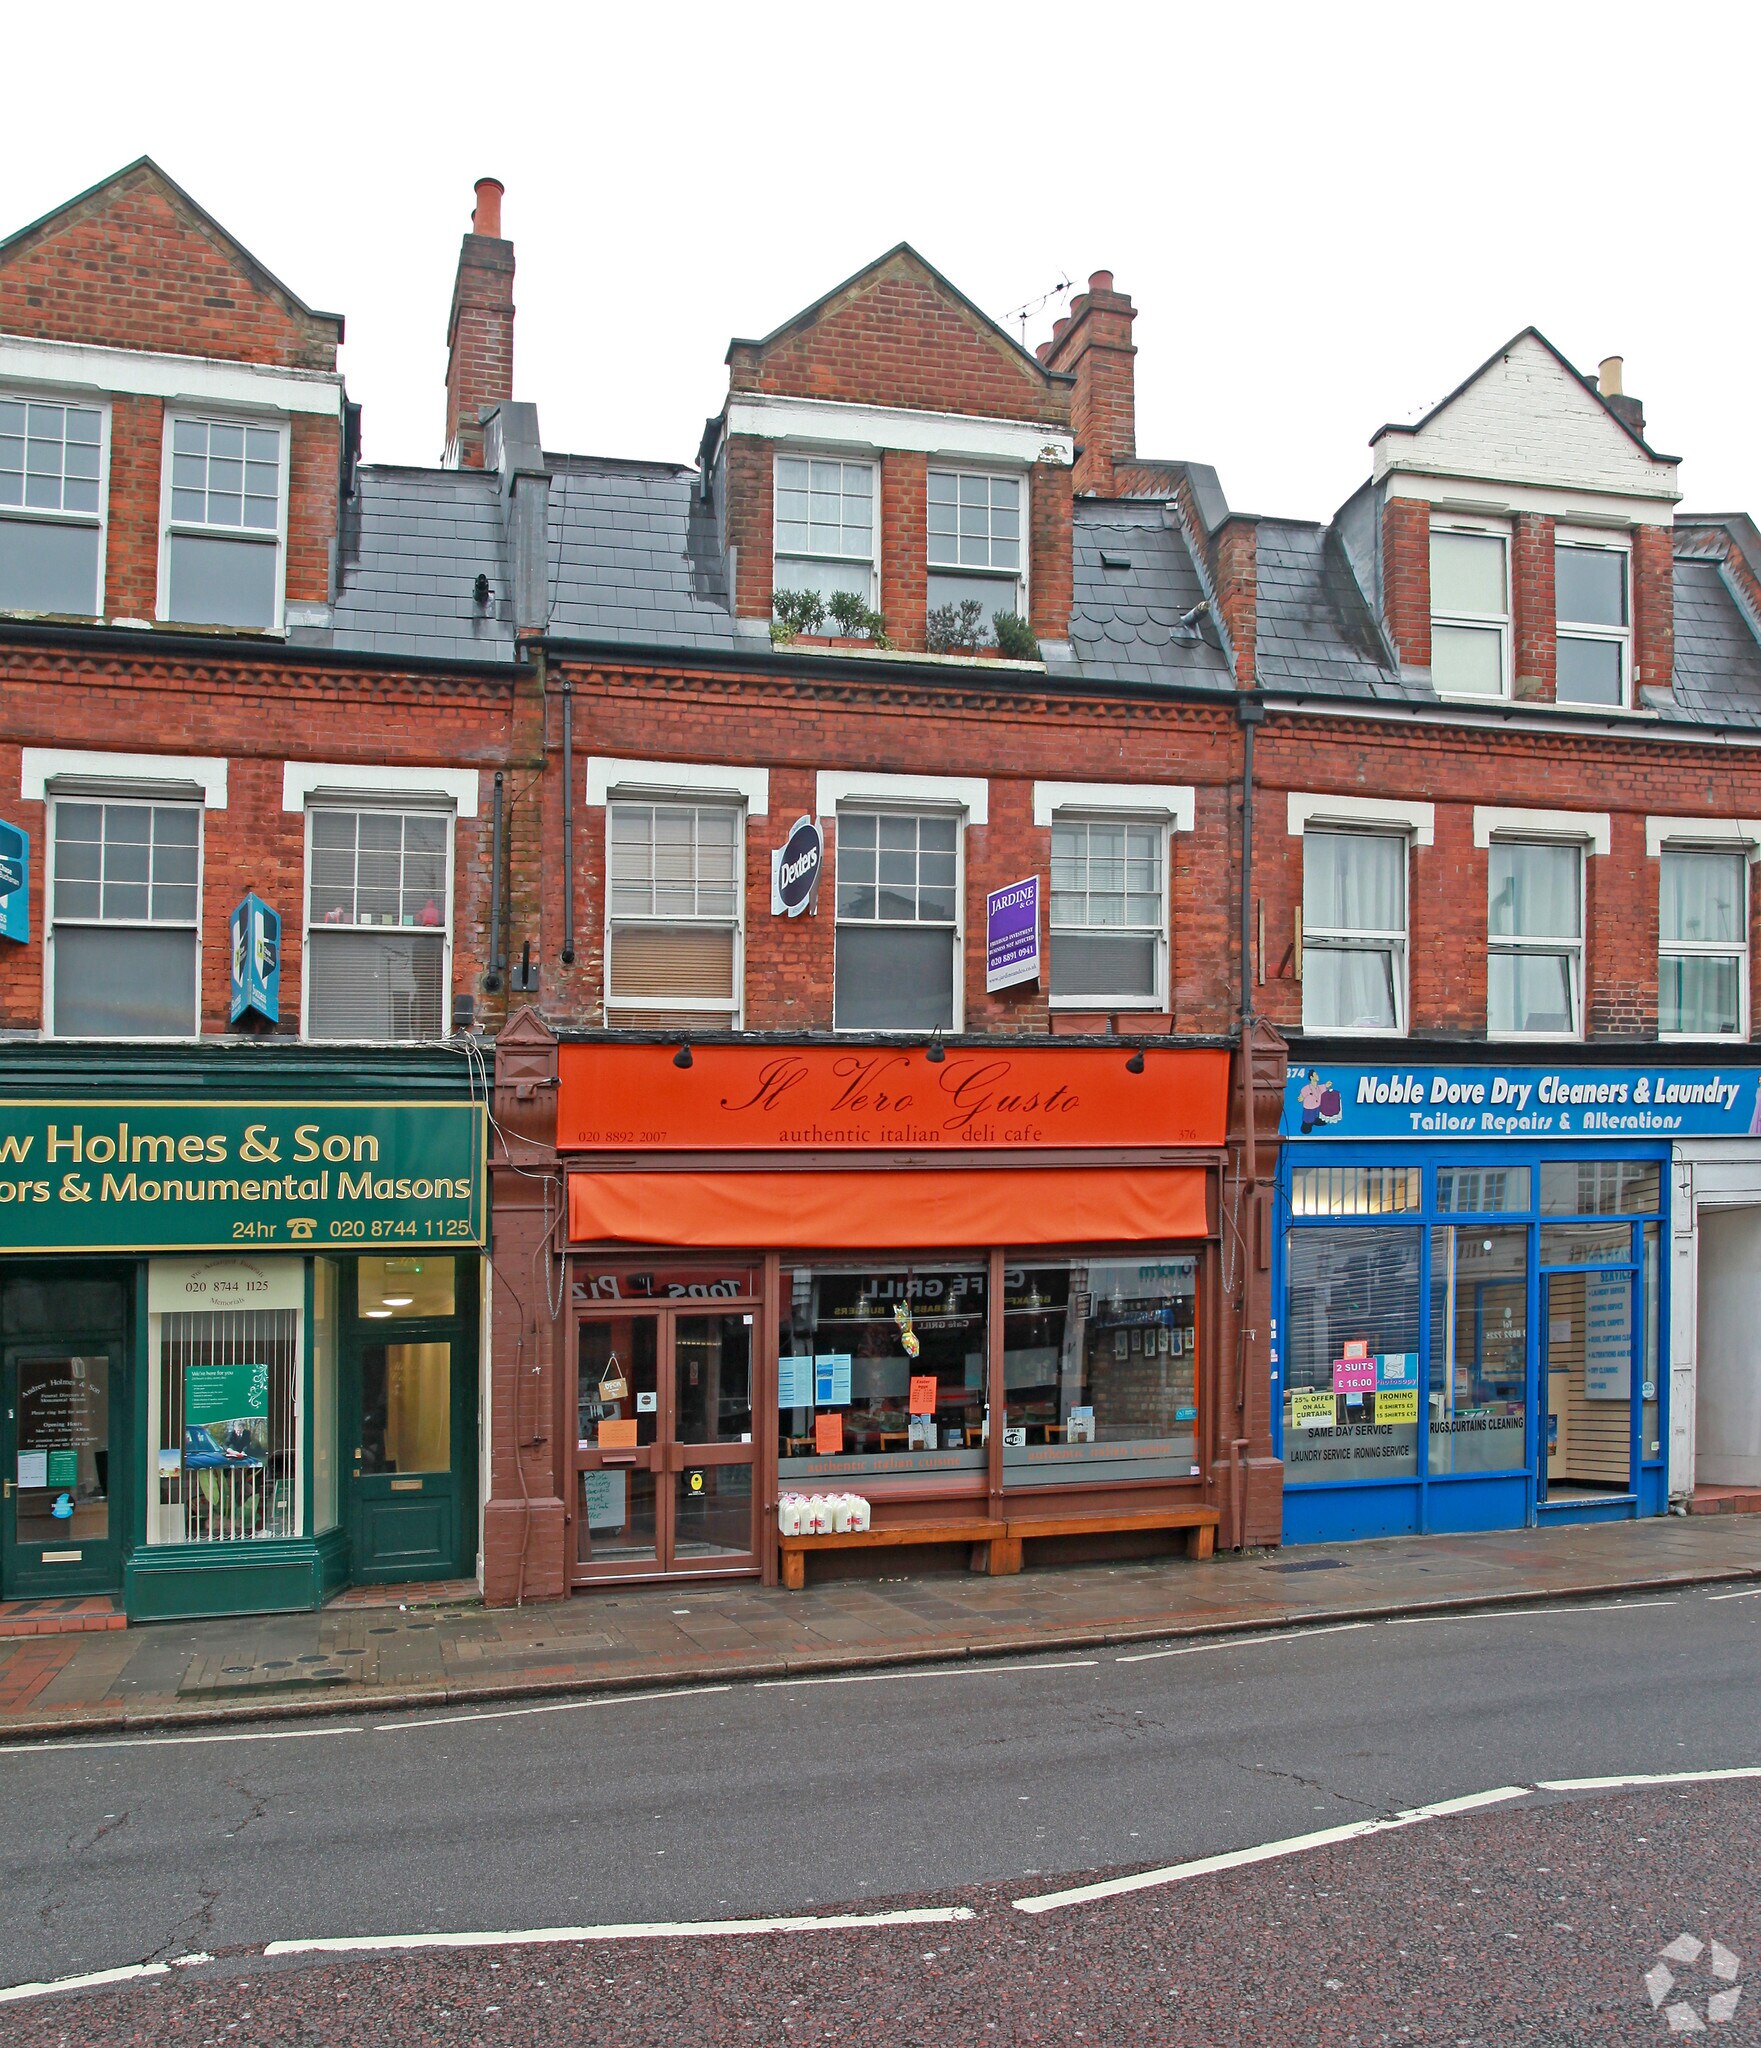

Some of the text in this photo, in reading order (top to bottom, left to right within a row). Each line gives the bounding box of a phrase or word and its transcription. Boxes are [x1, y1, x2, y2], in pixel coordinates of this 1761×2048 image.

[781, 846, 817, 890] Dexters
[991, 886, 1034, 916] JARDINE
[1006, 941, 1014, 949] NOT
[1015, 934, 1035, 947] AFFECTED
[1009, 927, 1034, 940] INVESTMENT
[991, 945, 1034, 967] 020 8891 0941
[1286, 1068, 1305, 1079] 374
[721, 1057, 1079, 1130] Il Vero Gusto
[1356, 1074, 1740, 1112] Noble Dove Dry Cleaners & Laundry
[1410, 1111, 1682, 1134] Tailors Repairs & Alterations
[578, 1131, 667, 1143] 020 8892 2007
[779, 1123, 1042, 1142] authentic italian deli cafe
[1178, 1129, 1197, 1140] 376
[47, 1122, 227, 1163] Holmes
[239, 1124, 282, 1163] &
[293, 1124, 380, 1162] Son
[58, 1172, 92, 1203] &
[100, 1170, 329, 1202] Monumental
[337, 1171, 471, 1200] Masons
[232, 1220, 469, 1238] 24hr 020 8744 1125
[185, 1281, 269, 1292] 020 8744 1125
[1336, 1362, 1374, 1372] 2 SUITS
[22, 1382, 46, 1398] Andrew
[50, 1378, 76, 1386] Holmes
[88, 1383, 100, 1394] Son
[1338, 1378, 1372, 1388] £ 16.00
[1296, 1410, 1332, 1419] CURTAINS
[1308, 1425, 1392, 1438] SAME DAY SERVICE
[1489, 1417, 1523, 1430] CLEANING
[1028, 1449, 1083, 1462] authentic
[1291, 1445, 1409, 1462] LAUNDRY SERVICE IRONING SERVICE
[808, 1456, 960, 1474] authentic italian cuisine
